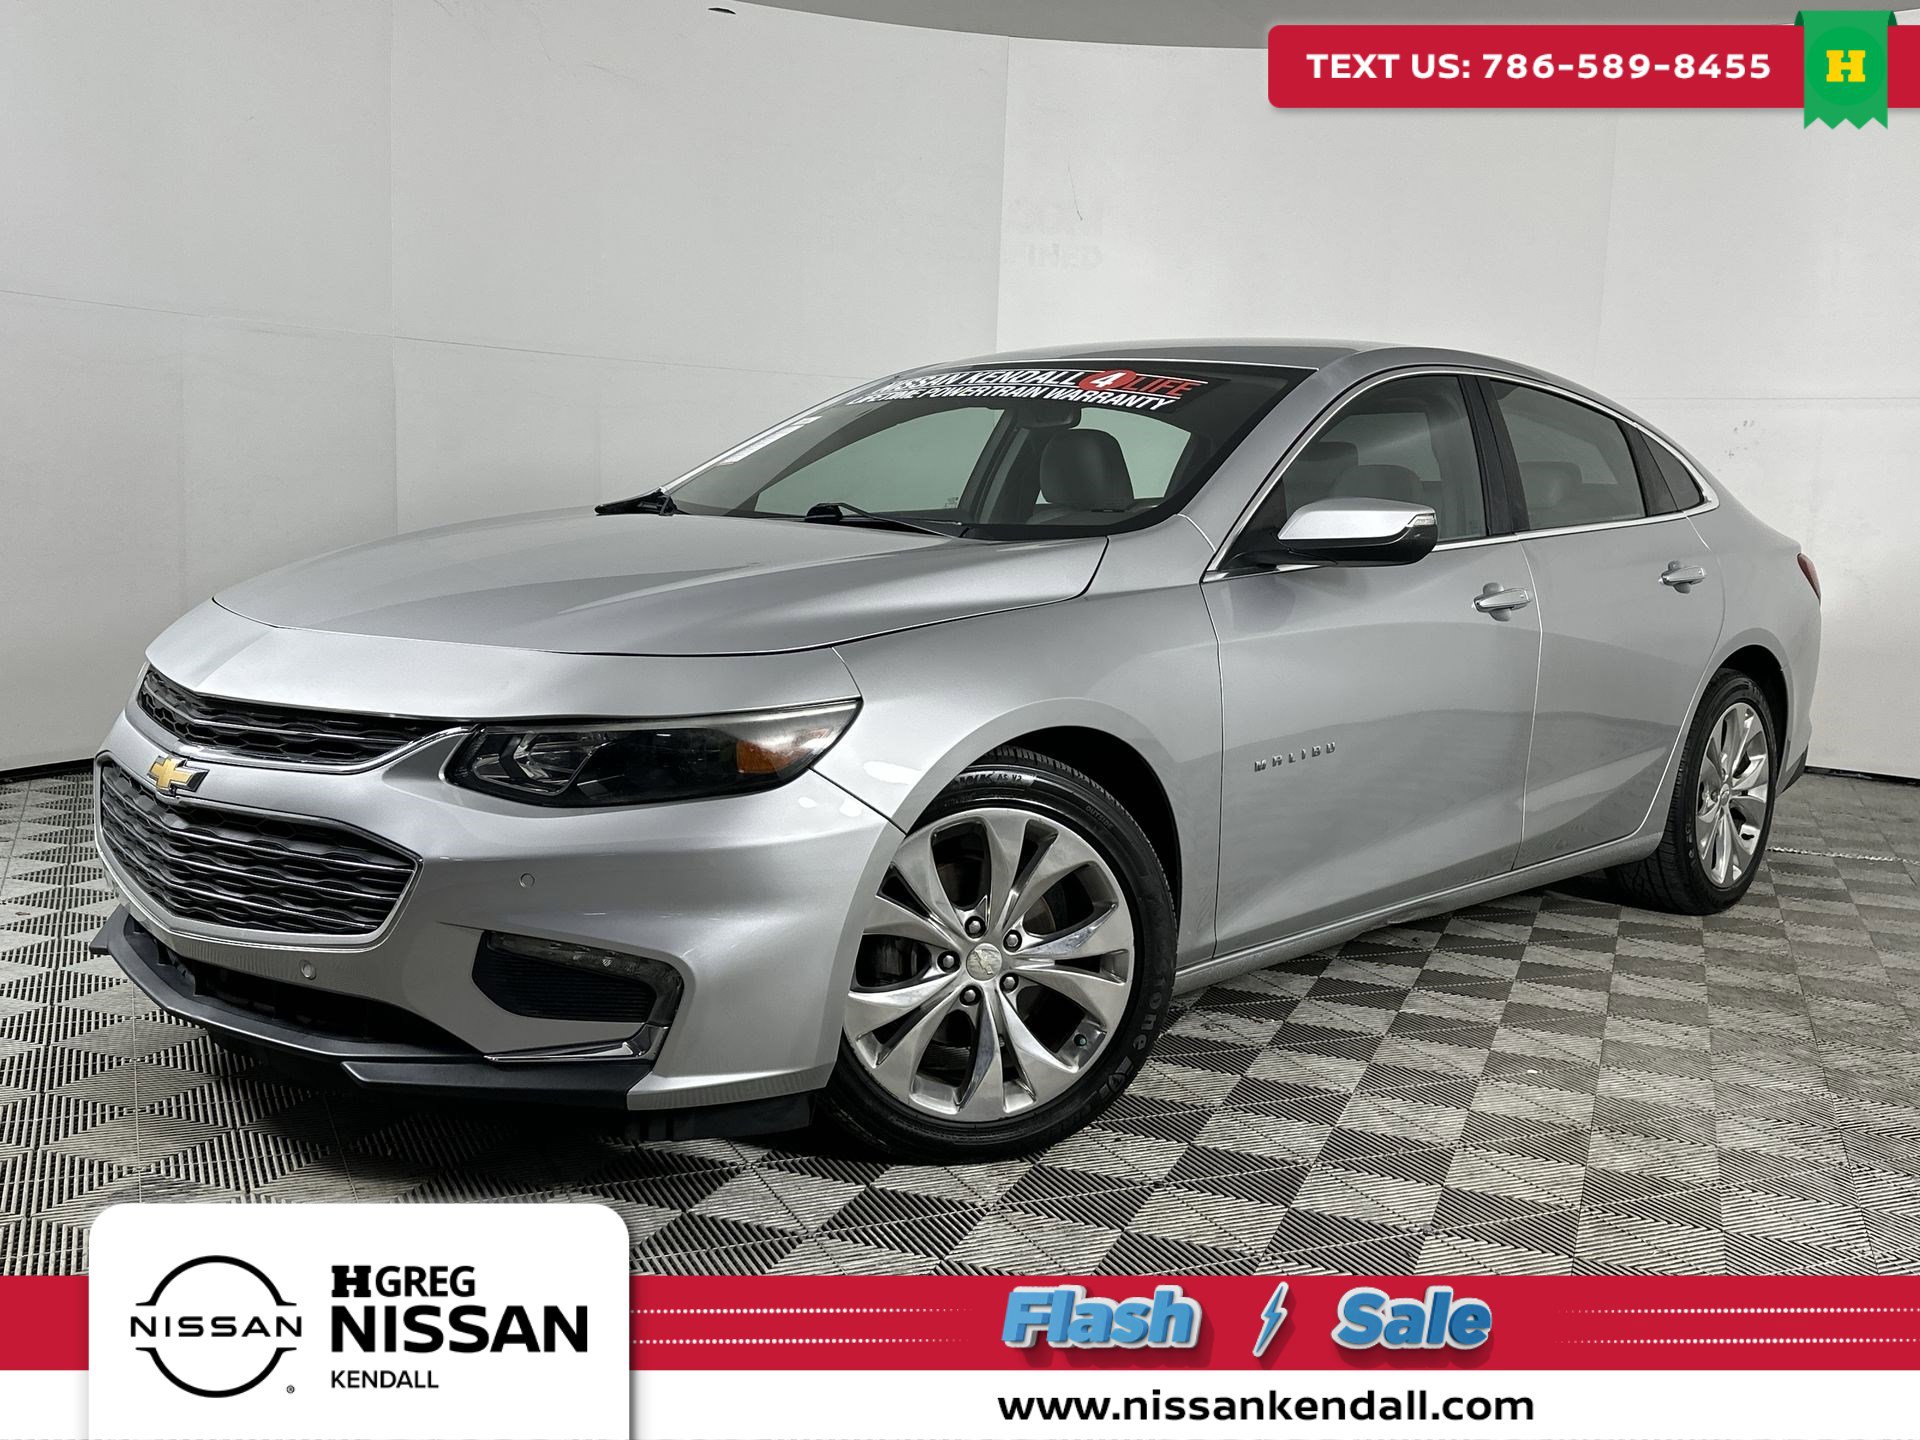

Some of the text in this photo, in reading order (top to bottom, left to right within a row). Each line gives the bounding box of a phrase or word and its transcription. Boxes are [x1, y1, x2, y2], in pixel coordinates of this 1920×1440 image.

[872, 370, 1201, 397] NISSAN KENDALL 4 LIFE
[917, 385, 1044, 399] POWERTRAIN
[1045, 388, 1177, 411] WARRANTY
[1254, 741, 1336, 773] MALIBU
